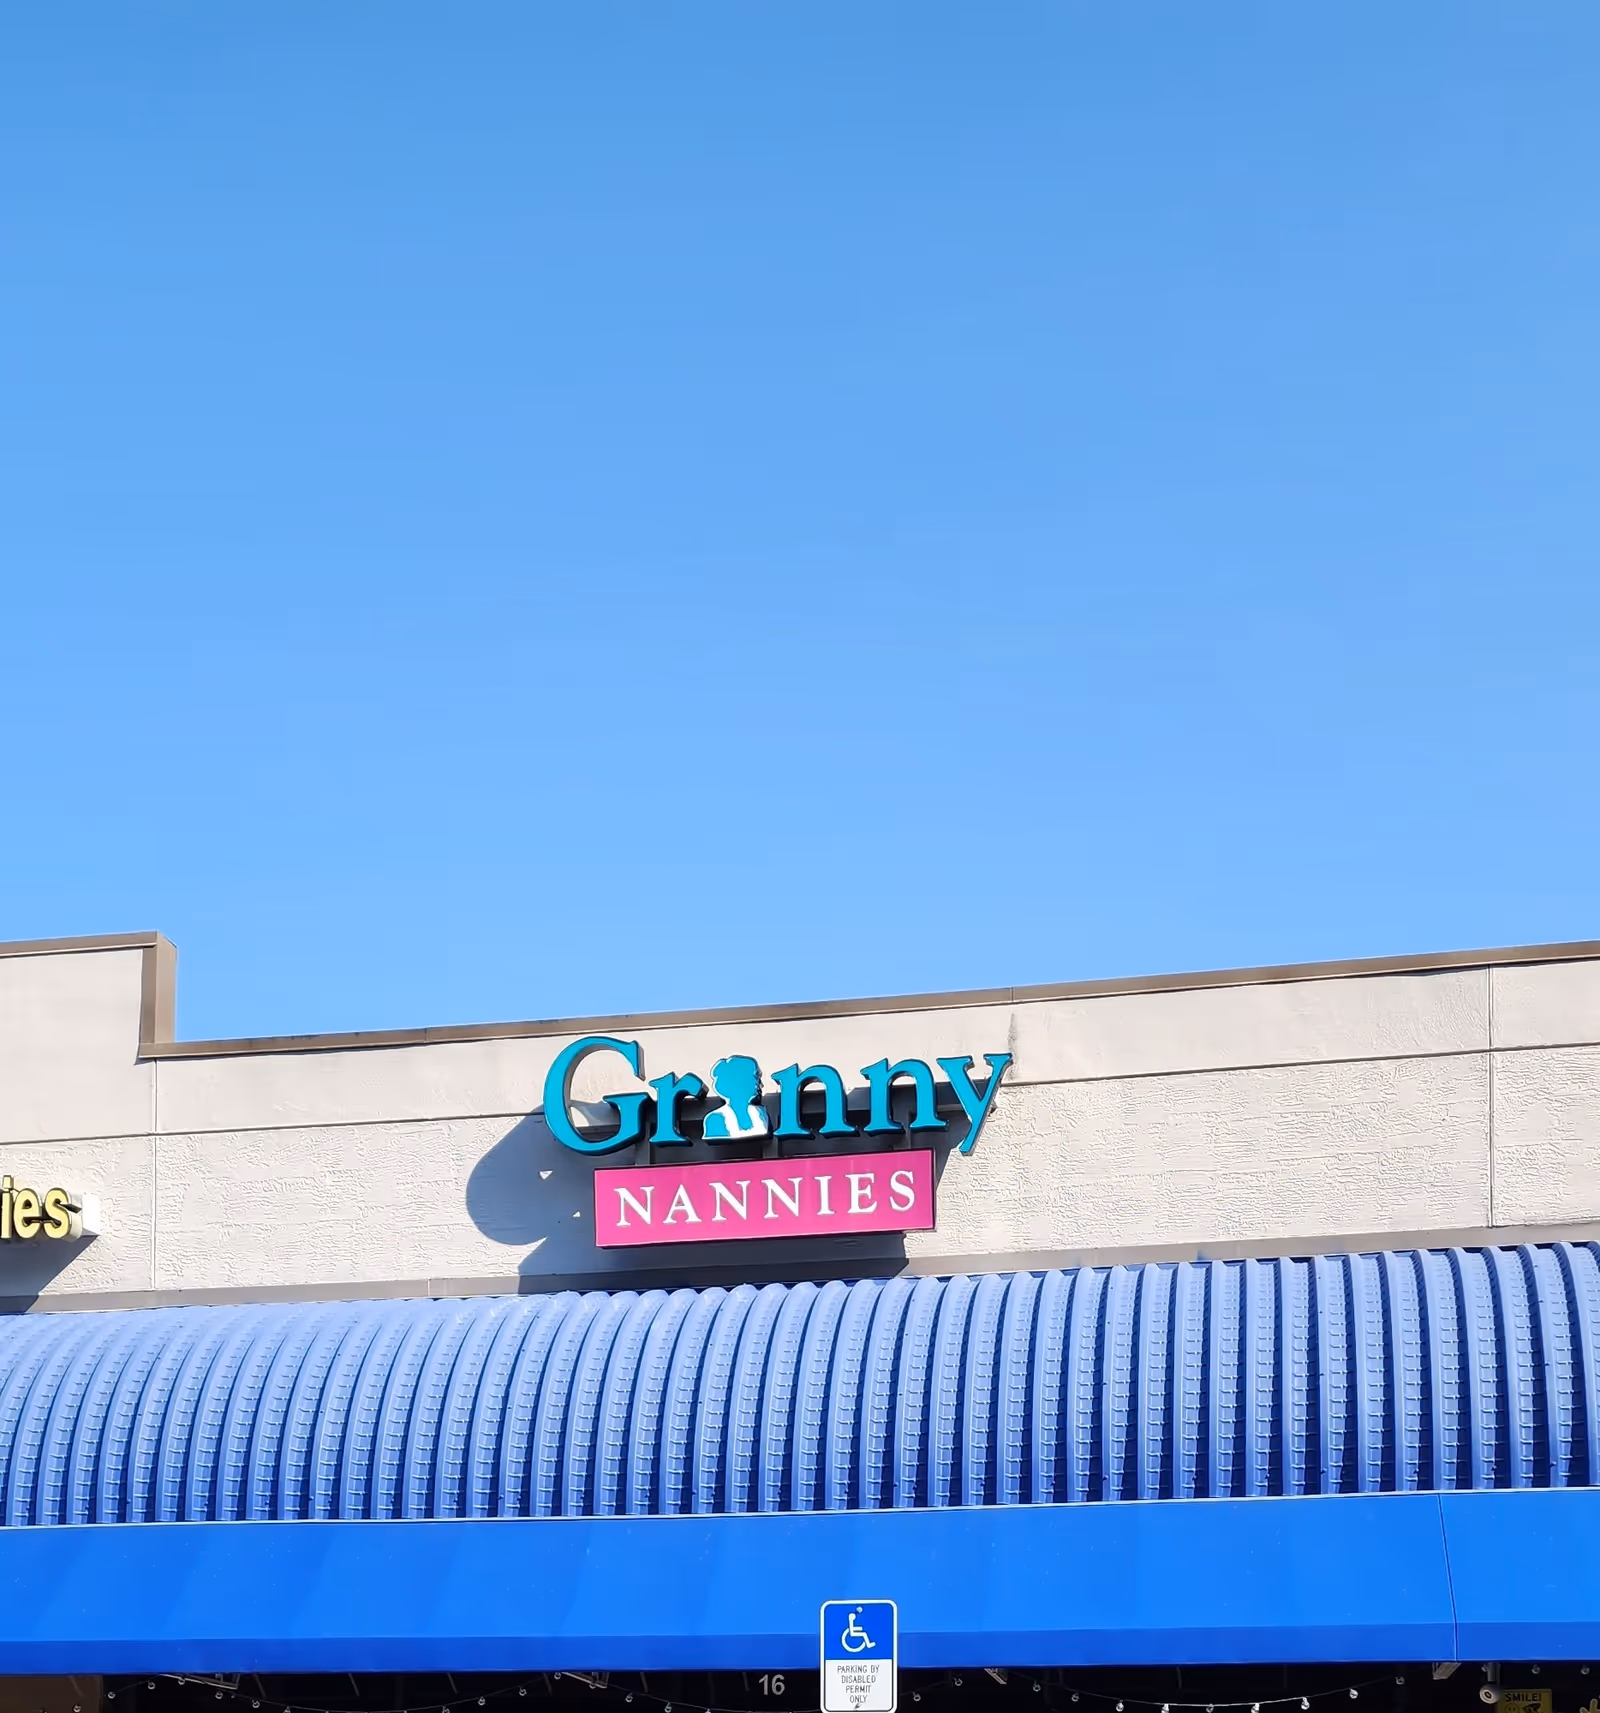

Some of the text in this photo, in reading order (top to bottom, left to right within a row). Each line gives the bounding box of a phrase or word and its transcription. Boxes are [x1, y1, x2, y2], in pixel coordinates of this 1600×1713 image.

[543, 1036, 1013, 1155] Grnny
[614, 1170, 916, 1227] NANNIES
[0, 1175, 73, 1240] ies
[837, 1665, 880, 1674] PARKING BY
[841, 1675, 876, 1683] DISABLED
[759, 1674, 785, 1696] 16
[846, 1685, 872, 1693] PERMIT
[850, 1695, 868, 1704] ONLY
[1505, 1693, 1542, 1702] SMILE!
